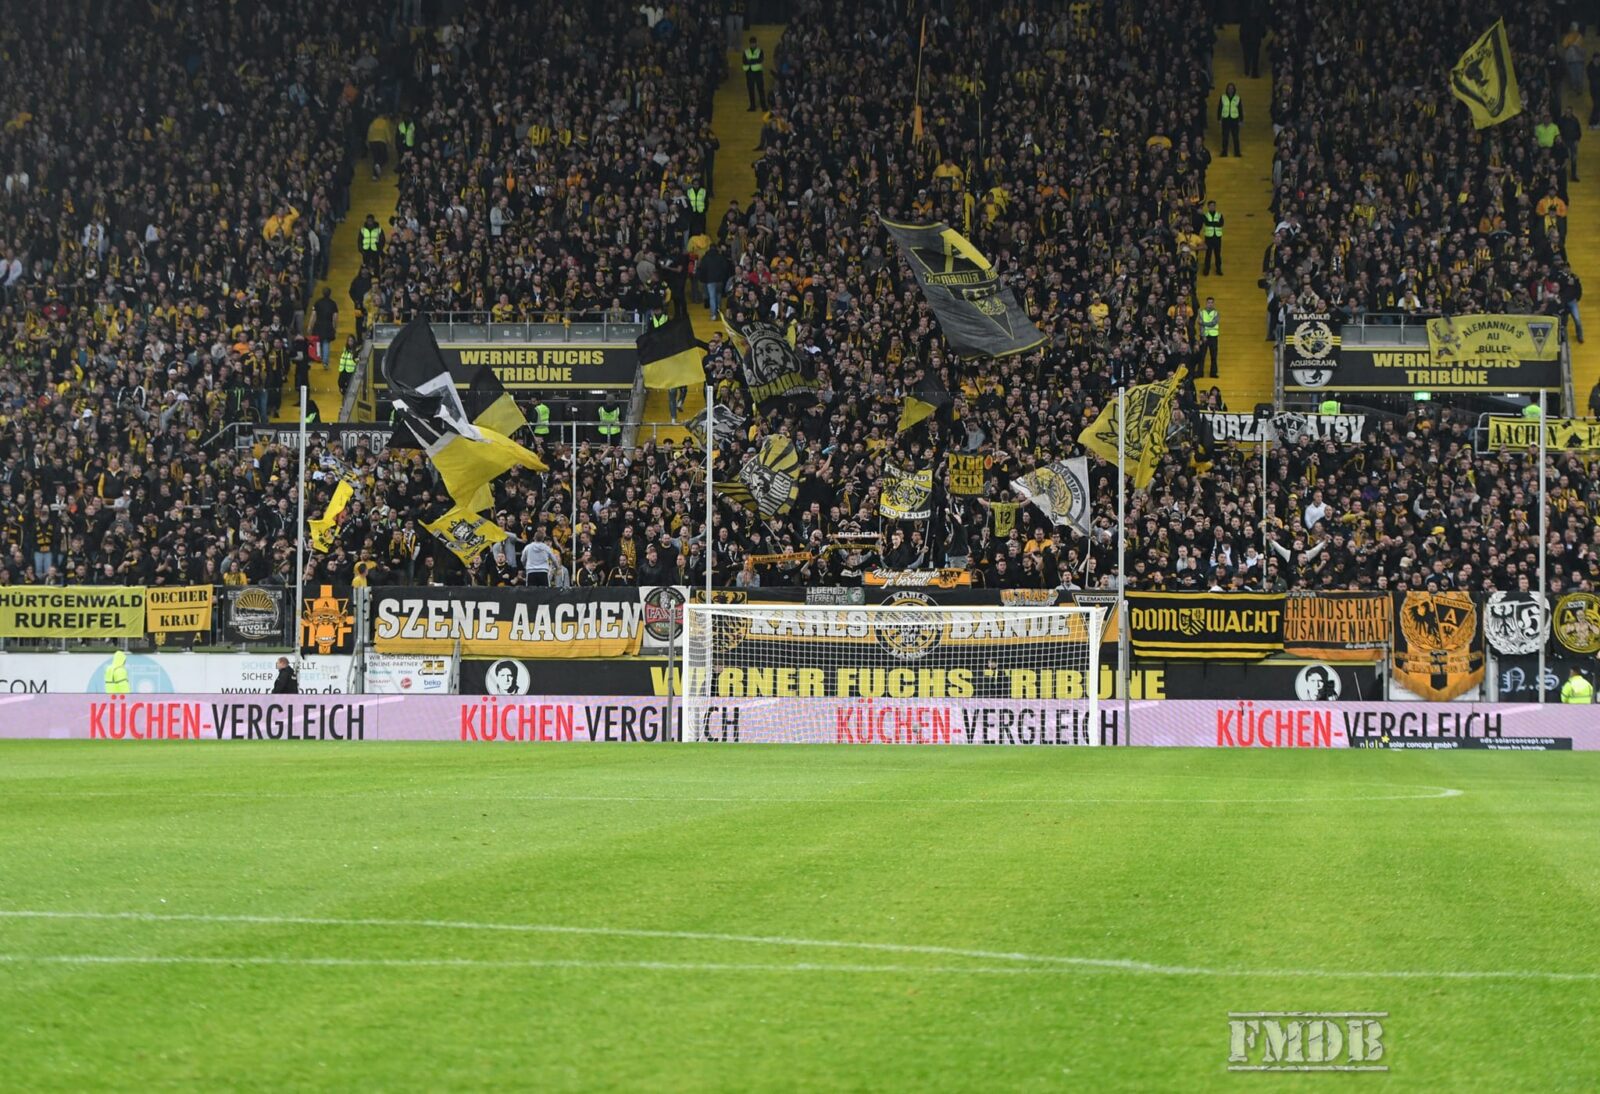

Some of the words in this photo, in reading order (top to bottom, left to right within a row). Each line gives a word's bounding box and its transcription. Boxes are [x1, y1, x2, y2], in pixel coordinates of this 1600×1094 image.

[460, 351, 539, 364] WERNER
[543, 351, 604, 364] FUCHS
[492, 366, 572, 381] TRIBÜNE
[1405, 369, 1488, 384] TRIBÜNE
[1000, 511, 1011, 524] 12
[0, 592, 143, 608] HÜRTGENWALD
[151, 590, 208, 603] OECHER
[1285, 598, 1386, 619] FREUNDSCHAFT
[15, 613, 126, 628] RUREIFEL
[160, 614, 199, 627] KRAU
[378, 599, 500, 639] SZENE
[509, 601, 641, 641] AACHEN
[1206, 608, 1281, 633] WACHT
[1284, 619, 1388, 641] ZUSAMMENHALT
[242, 672, 273, 680] SICHER
[837, 668, 974, 698] FUCHS
[90, 695, 364, 740] KÜCHEN-VERGLEICH
